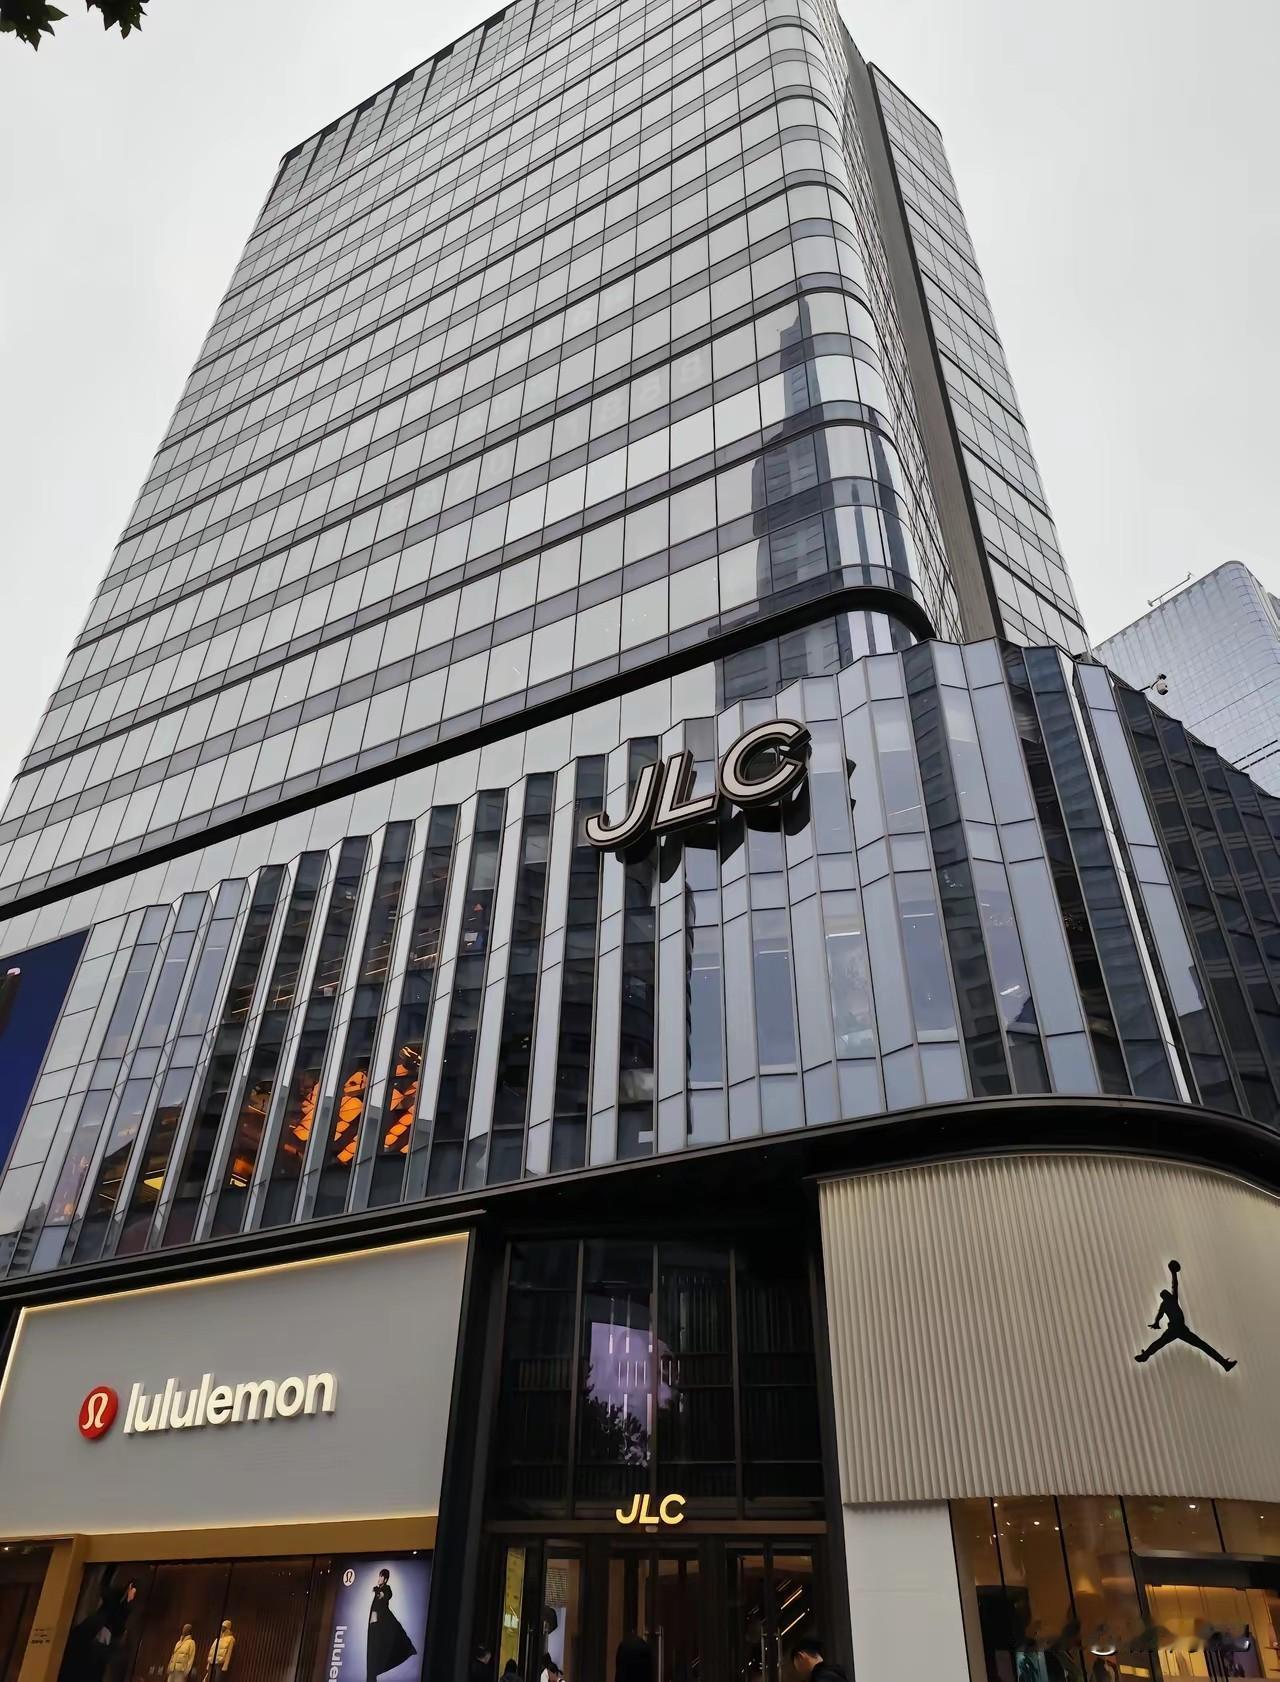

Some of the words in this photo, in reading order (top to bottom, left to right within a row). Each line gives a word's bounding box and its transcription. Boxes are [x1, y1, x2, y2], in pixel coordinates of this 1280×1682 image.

[586, 719, 811, 847] JLC
[123, 1372, 337, 1434] lululemon
[615, 1493, 686, 1525] JLC
